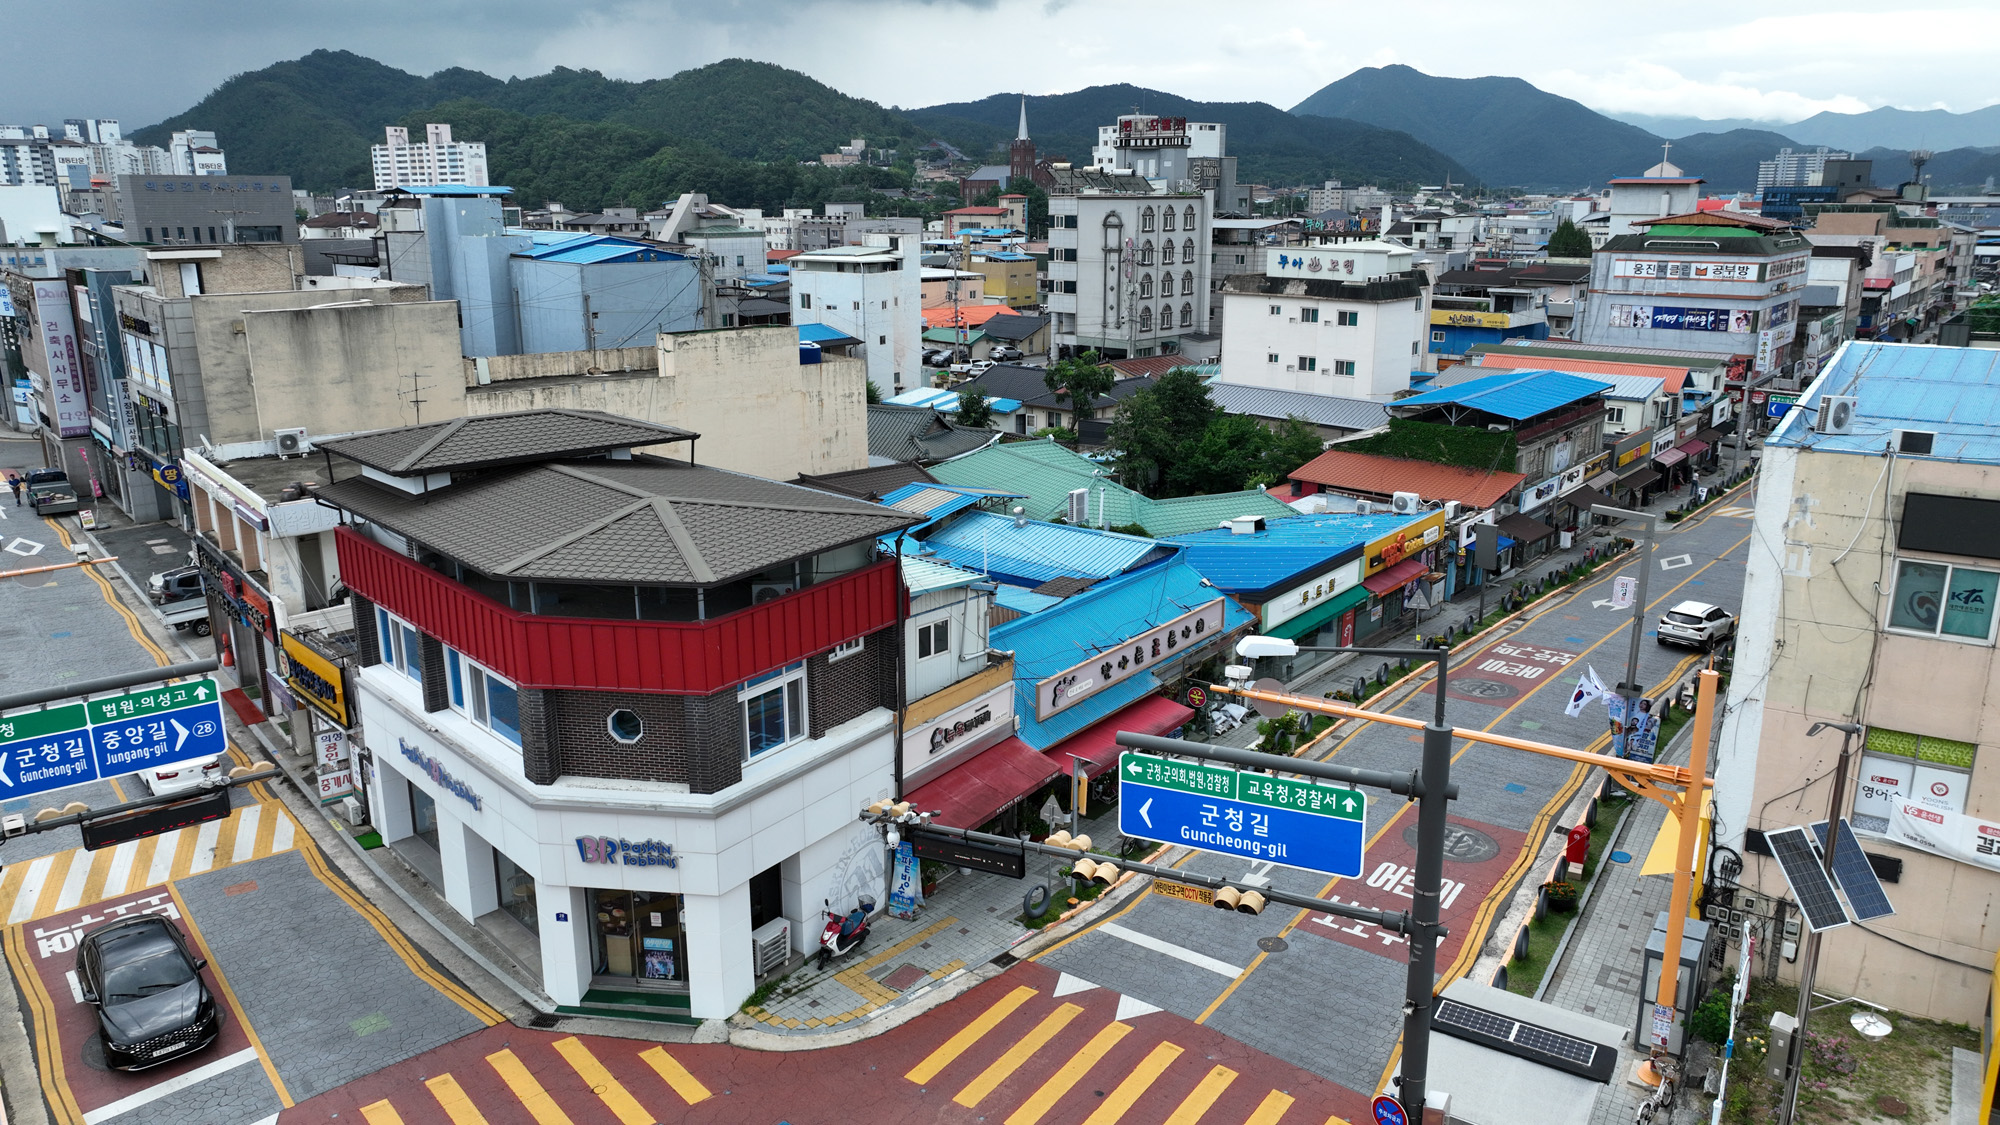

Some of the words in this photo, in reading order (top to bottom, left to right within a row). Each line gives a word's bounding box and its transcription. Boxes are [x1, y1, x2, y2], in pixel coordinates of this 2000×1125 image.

[58, 157, 85, 165] 대동타운
[198, 162, 223, 170] 대동타운
[1203, 167, 1221, 177] TODAY
[1327, 258, 1355, 275] 모텔
[1712, 265, 1750, 276] 공부방
[46, 321, 75, 403] 건축사사무소
[121, 381, 131, 400] 법무사
[128, 428, 139, 447] 사무소
[1951, 588, 1985, 605] KTA
[1491, 643, 1577, 666] 보호구역
[1477, 659, 1546, 679] 어린이
[102, 690, 188, 718] 법원·의성고
[102, 721, 167, 749] 중앙길
[196, 723, 213, 736] 28
[320, 731, 343, 743] 의성
[15, 737, 85, 768] 군청길
[106, 742, 169, 765] Jungang-gil
[324, 742, 339, 761] 공인
[20, 759, 88, 784] Guncheong-gil
[321, 773, 352, 792] 중개사
[1146, 762, 1230, 794] 군청,군의회,법원,검찰청
[1247, 781, 1336, 810] 교육청,경찰서
[1921, 796, 1949, 806] YOONS
[1199, 803, 1270, 838] 군청길
[1921, 810, 1943, 824] 윤선생
[575, 835, 620, 865] BR
[619, 838, 673, 856] baskin
[1180, 825, 1288, 858] Guncheong-gil
[1903, 832, 1936, 849] 1588-0594
[623, 853, 680, 870] robbins
[1155, 881, 1184, 898] 어린이보호구역
[1184, 887, 1199, 901] CCTV
[1199, 890, 1212, 904] 작동중
[34, 892, 180, 959] 보역
